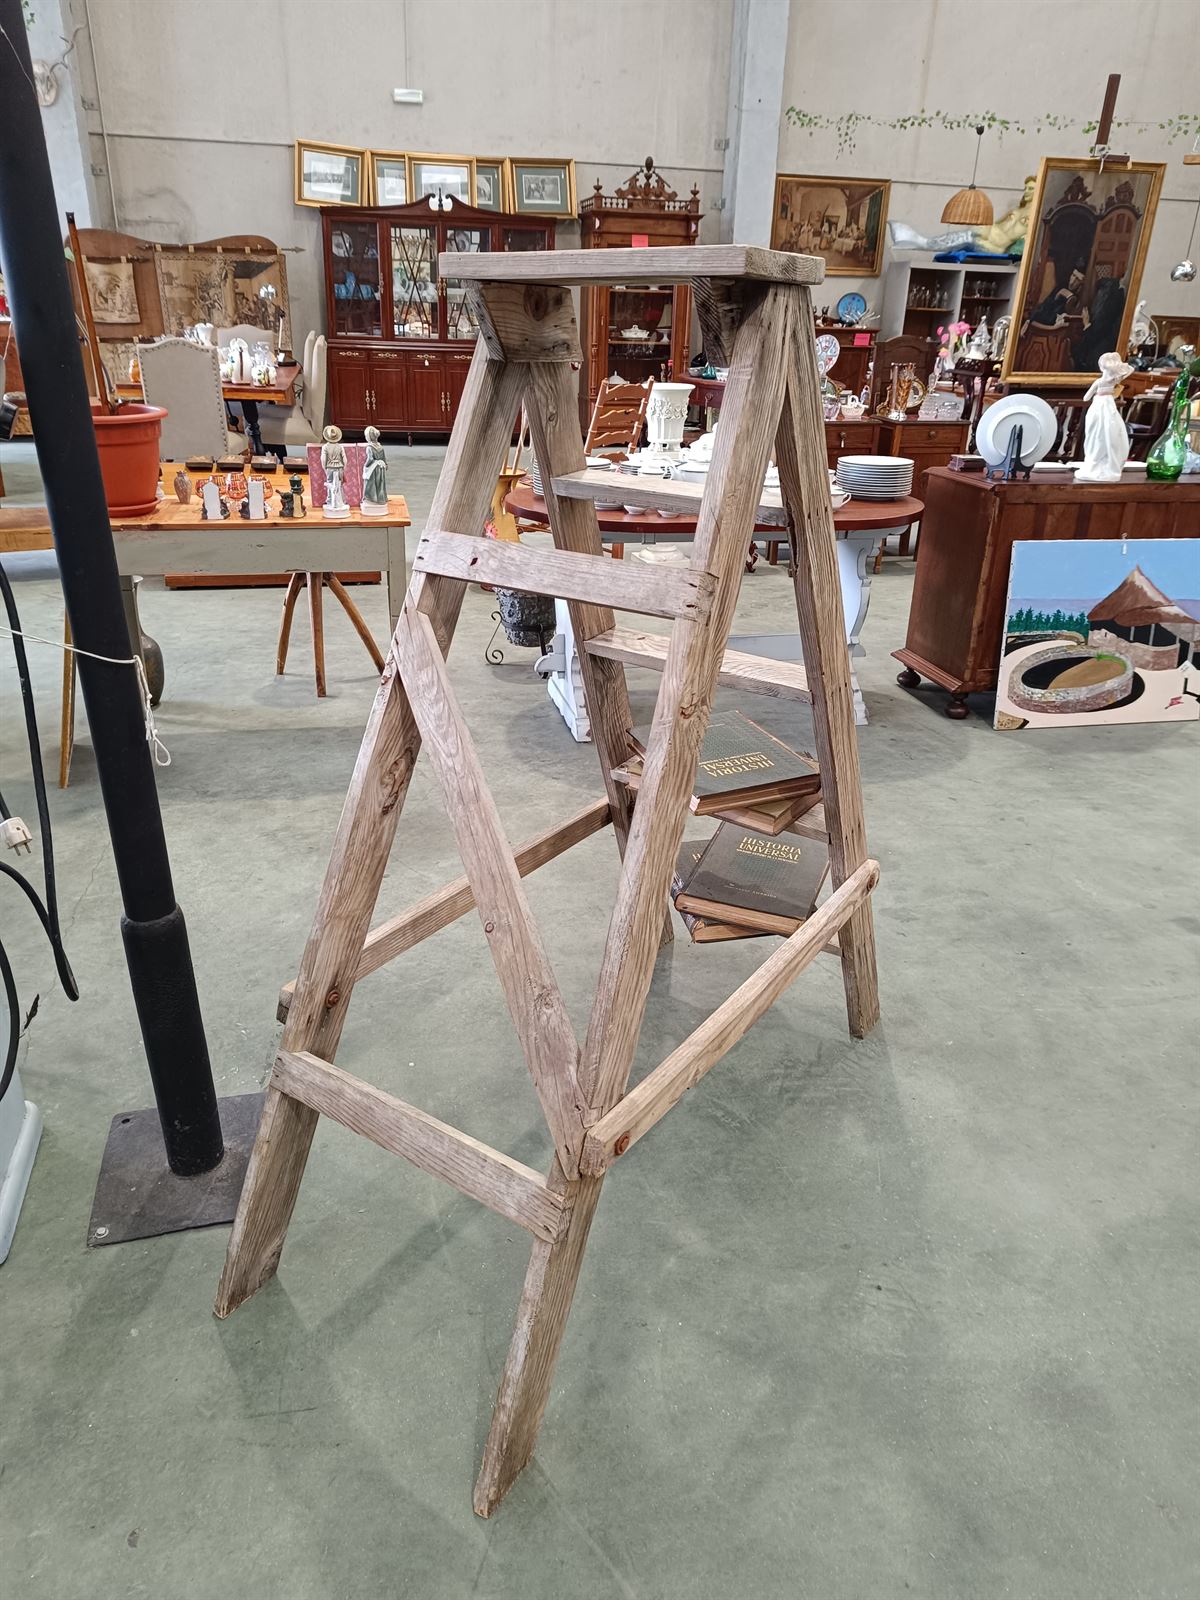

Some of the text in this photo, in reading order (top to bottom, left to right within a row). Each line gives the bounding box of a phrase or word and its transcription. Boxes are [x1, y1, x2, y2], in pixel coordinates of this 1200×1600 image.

[700, 754, 767, 771] UNIVERSAL
[707, 760, 775, 777] HISTORIA
[739, 843, 799, 861] UNIVERSAL
[742, 837, 801, 855] HISTORIA
